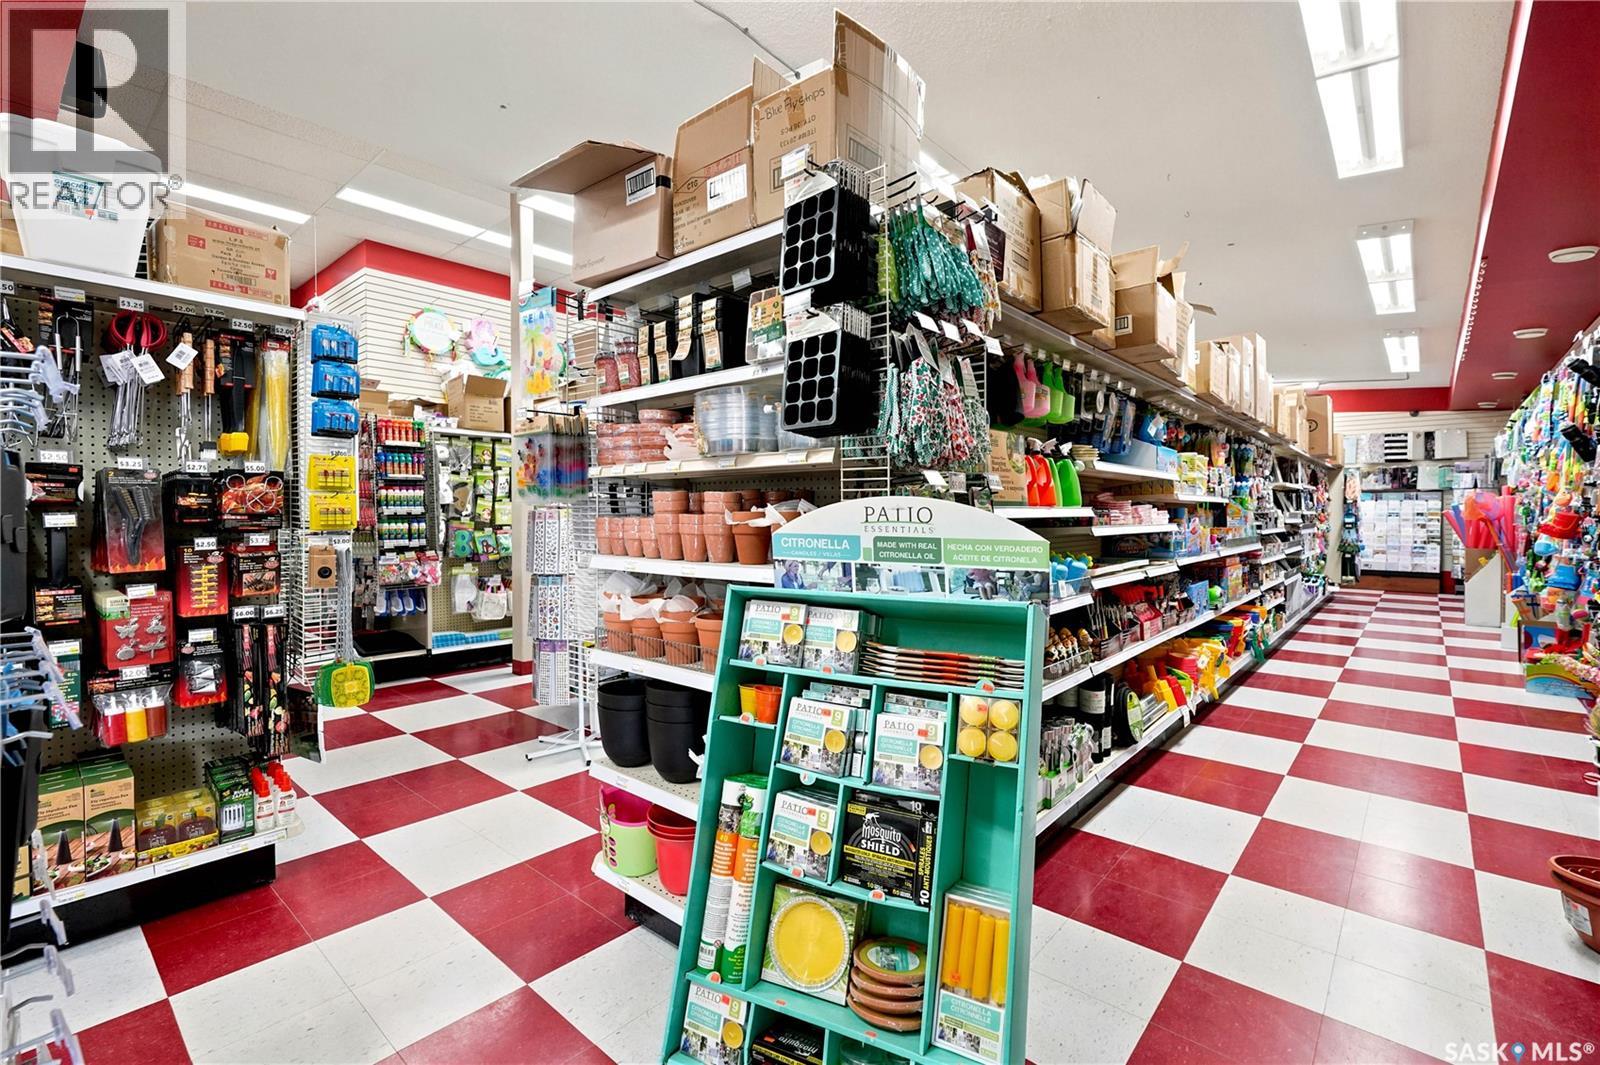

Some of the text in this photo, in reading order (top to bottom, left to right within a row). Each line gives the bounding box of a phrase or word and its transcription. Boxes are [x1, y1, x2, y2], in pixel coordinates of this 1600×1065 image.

[120, 299, 144, 310] $3.25
[233, 320, 253, 330] $2.50
[275, 327, 295, 336] $2.00
[864, 505, 934, 524] PATIO
[864, 525, 934, 535] ESSENTIALS
[781, 537, 850, 551] CITRONELLA
[876, 541, 897, 550] MADE
[918, 543, 937, 551] REAL
[947, 544, 973, 552] HECHA
[994, 545, 1044, 554] VERDADERO
[879, 551, 921, 560] CITRONELLA
[952, 554, 979, 562] ACEITE
[993, 556, 1038, 564] CITRONELA
[755, 604, 782, 615] PATIO
[123, 669, 147, 678] $2.00
[797, 703, 823, 716] PATIO
[884, 720, 915, 731] PATIO
[910, 800, 922, 811] 10
[820, 812, 828, 822] 9
[861, 824, 902, 844] Mosquito
[860, 839, 901, 857] SHIELD
[918, 847, 926, 876] SPIRALES
[919, 835, 934, 906] 10 ANTI-MOUSTIQUES
[695, 986, 721, 1004] PATIO
[731, 1000, 740, 1013] 9
